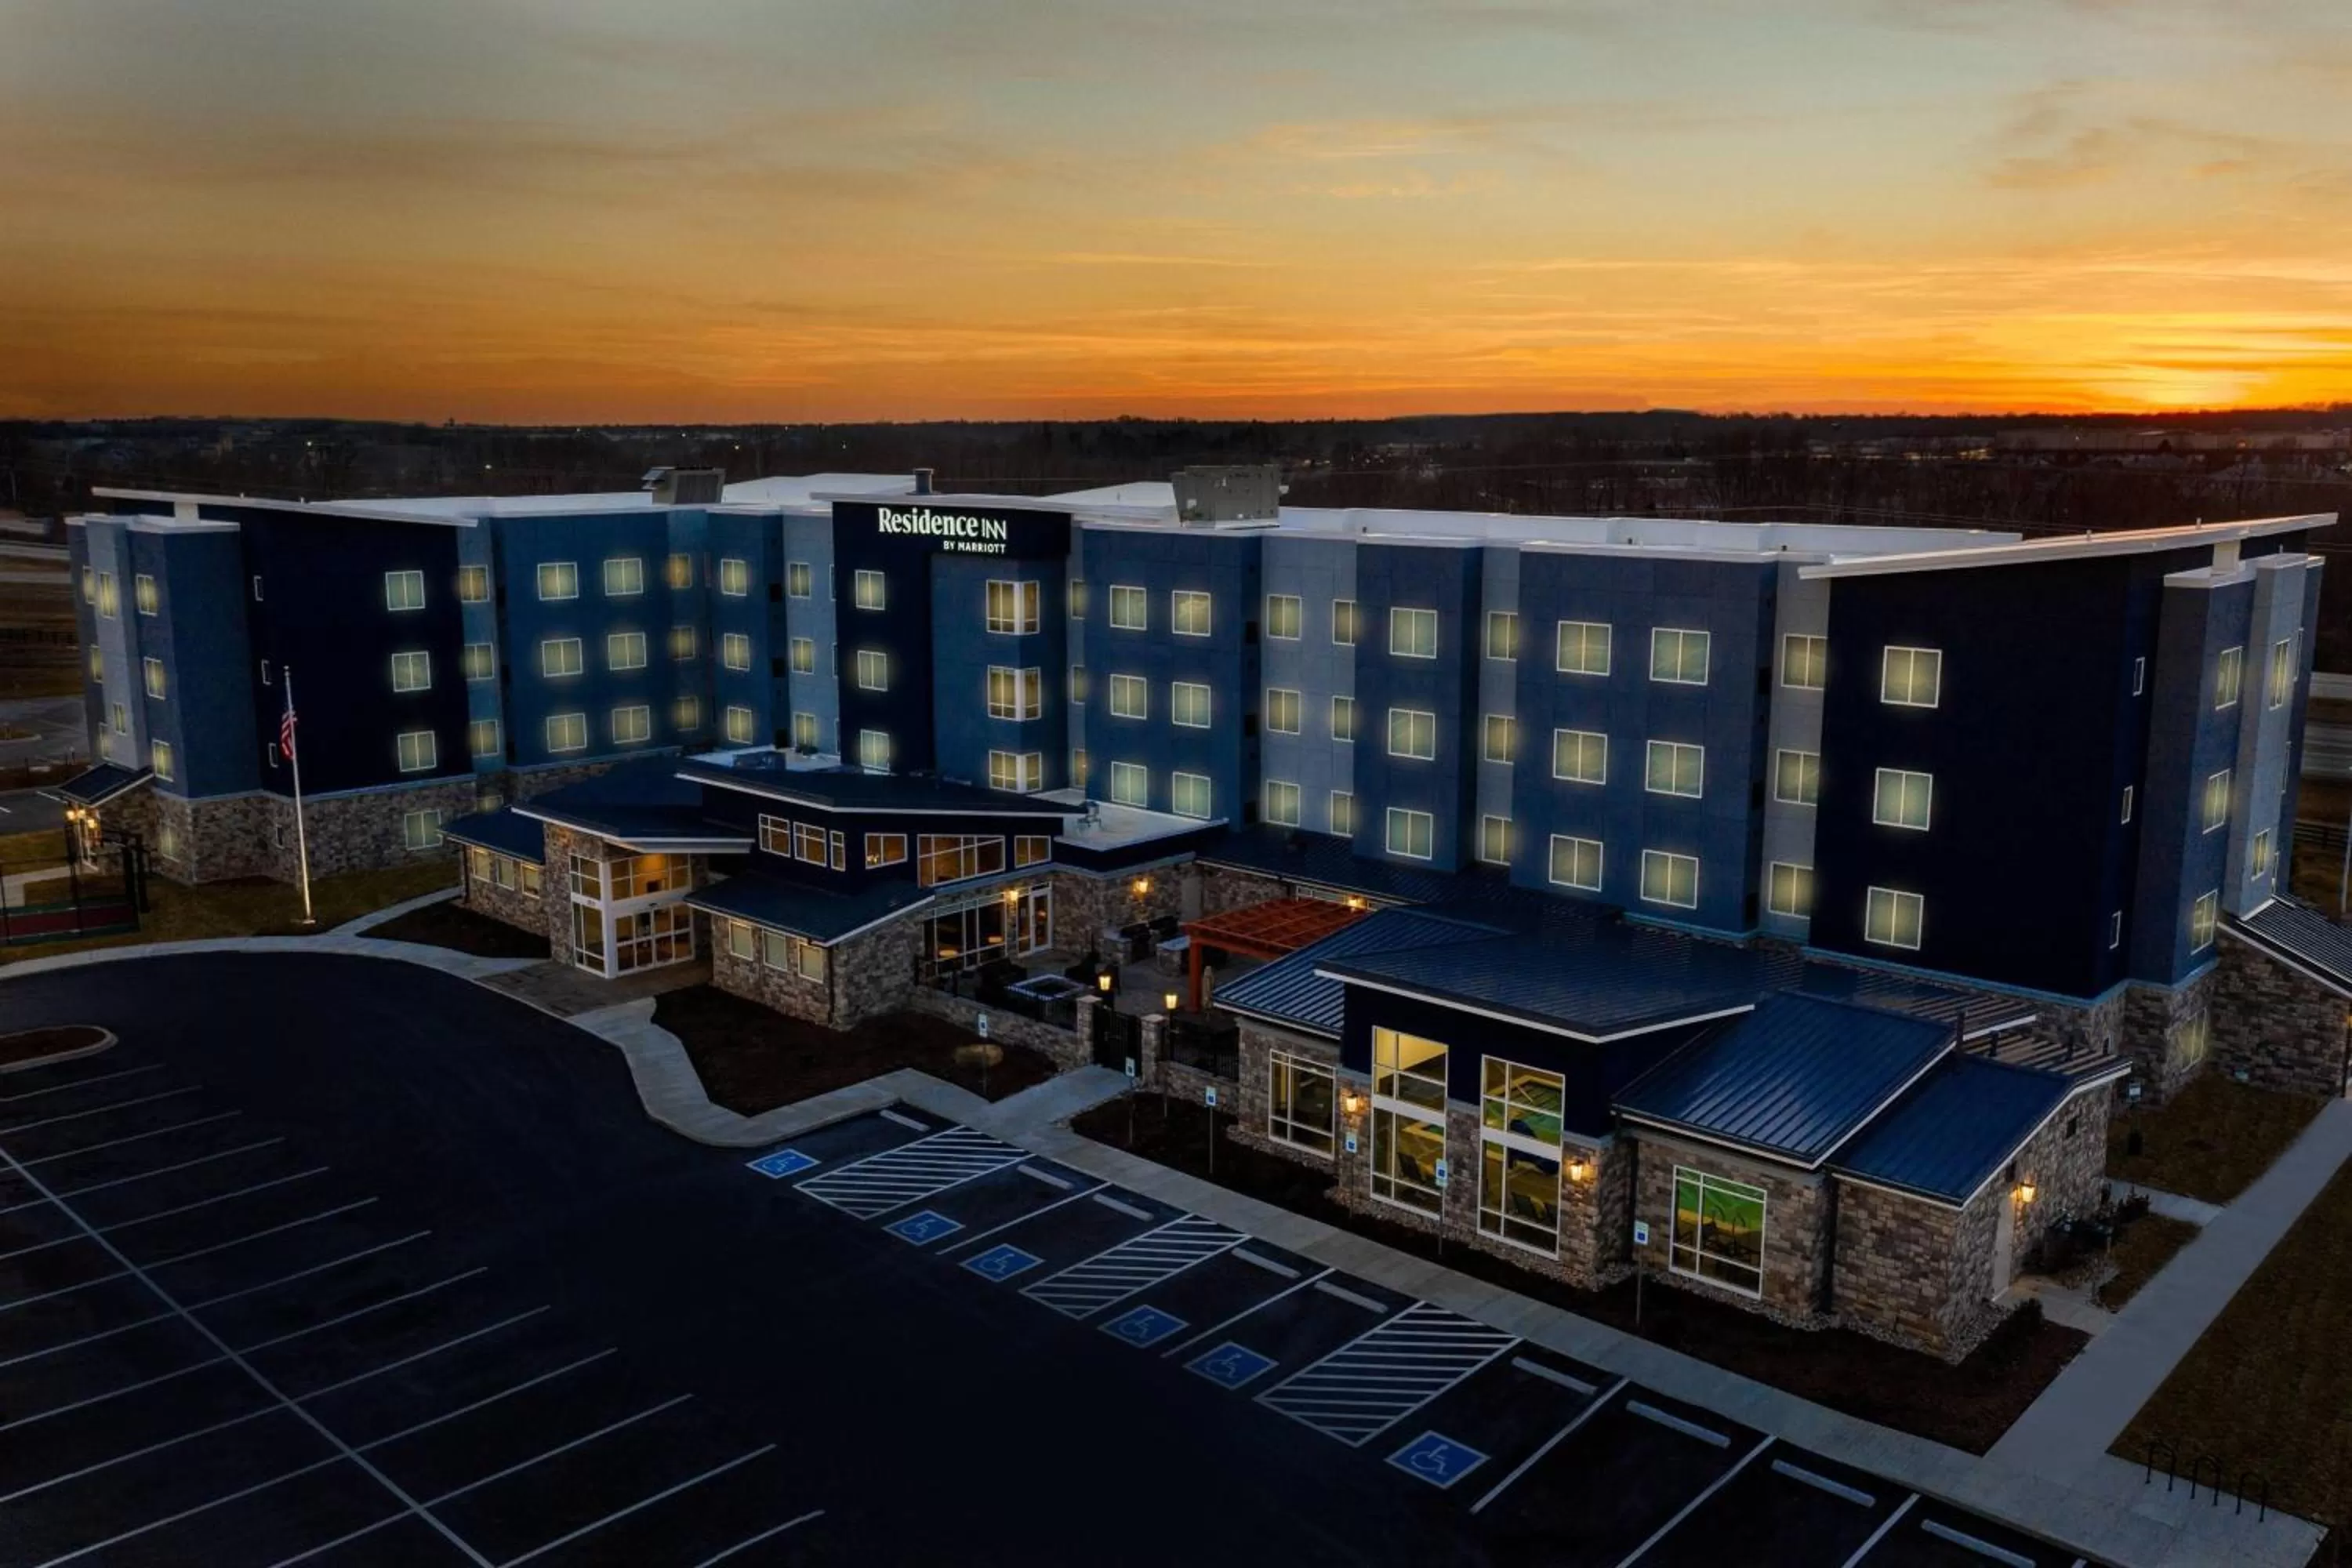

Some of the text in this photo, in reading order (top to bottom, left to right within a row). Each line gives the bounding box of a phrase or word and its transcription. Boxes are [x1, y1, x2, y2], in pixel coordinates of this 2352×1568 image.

[878, 508, 1007, 539] Residence INN
[943, 541, 1006, 554] BY MARRIOTT
